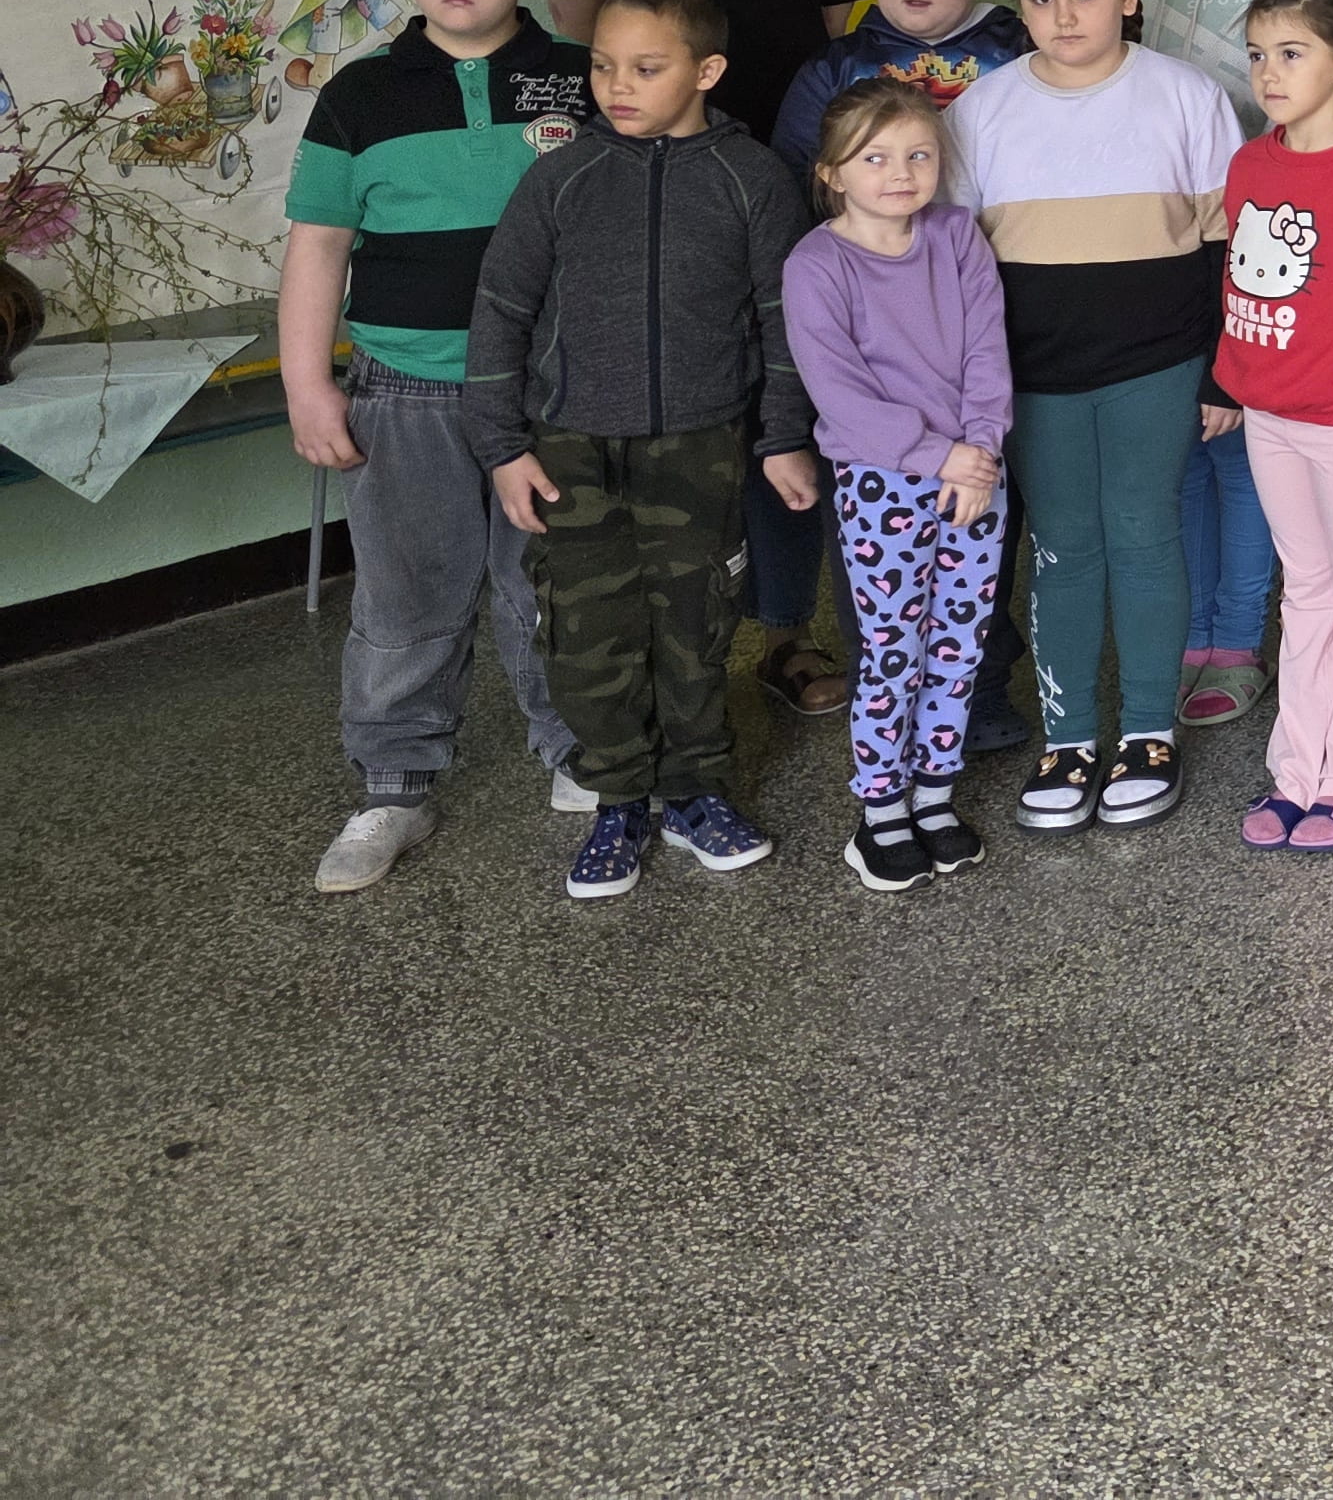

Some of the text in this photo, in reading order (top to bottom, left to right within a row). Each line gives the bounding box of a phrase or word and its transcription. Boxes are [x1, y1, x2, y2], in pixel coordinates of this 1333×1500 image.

[540, 126, 573, 140] 1984
[1227, 293, 1296, 329] HELLO
[1225, 312, 1296, 350] KITTY
